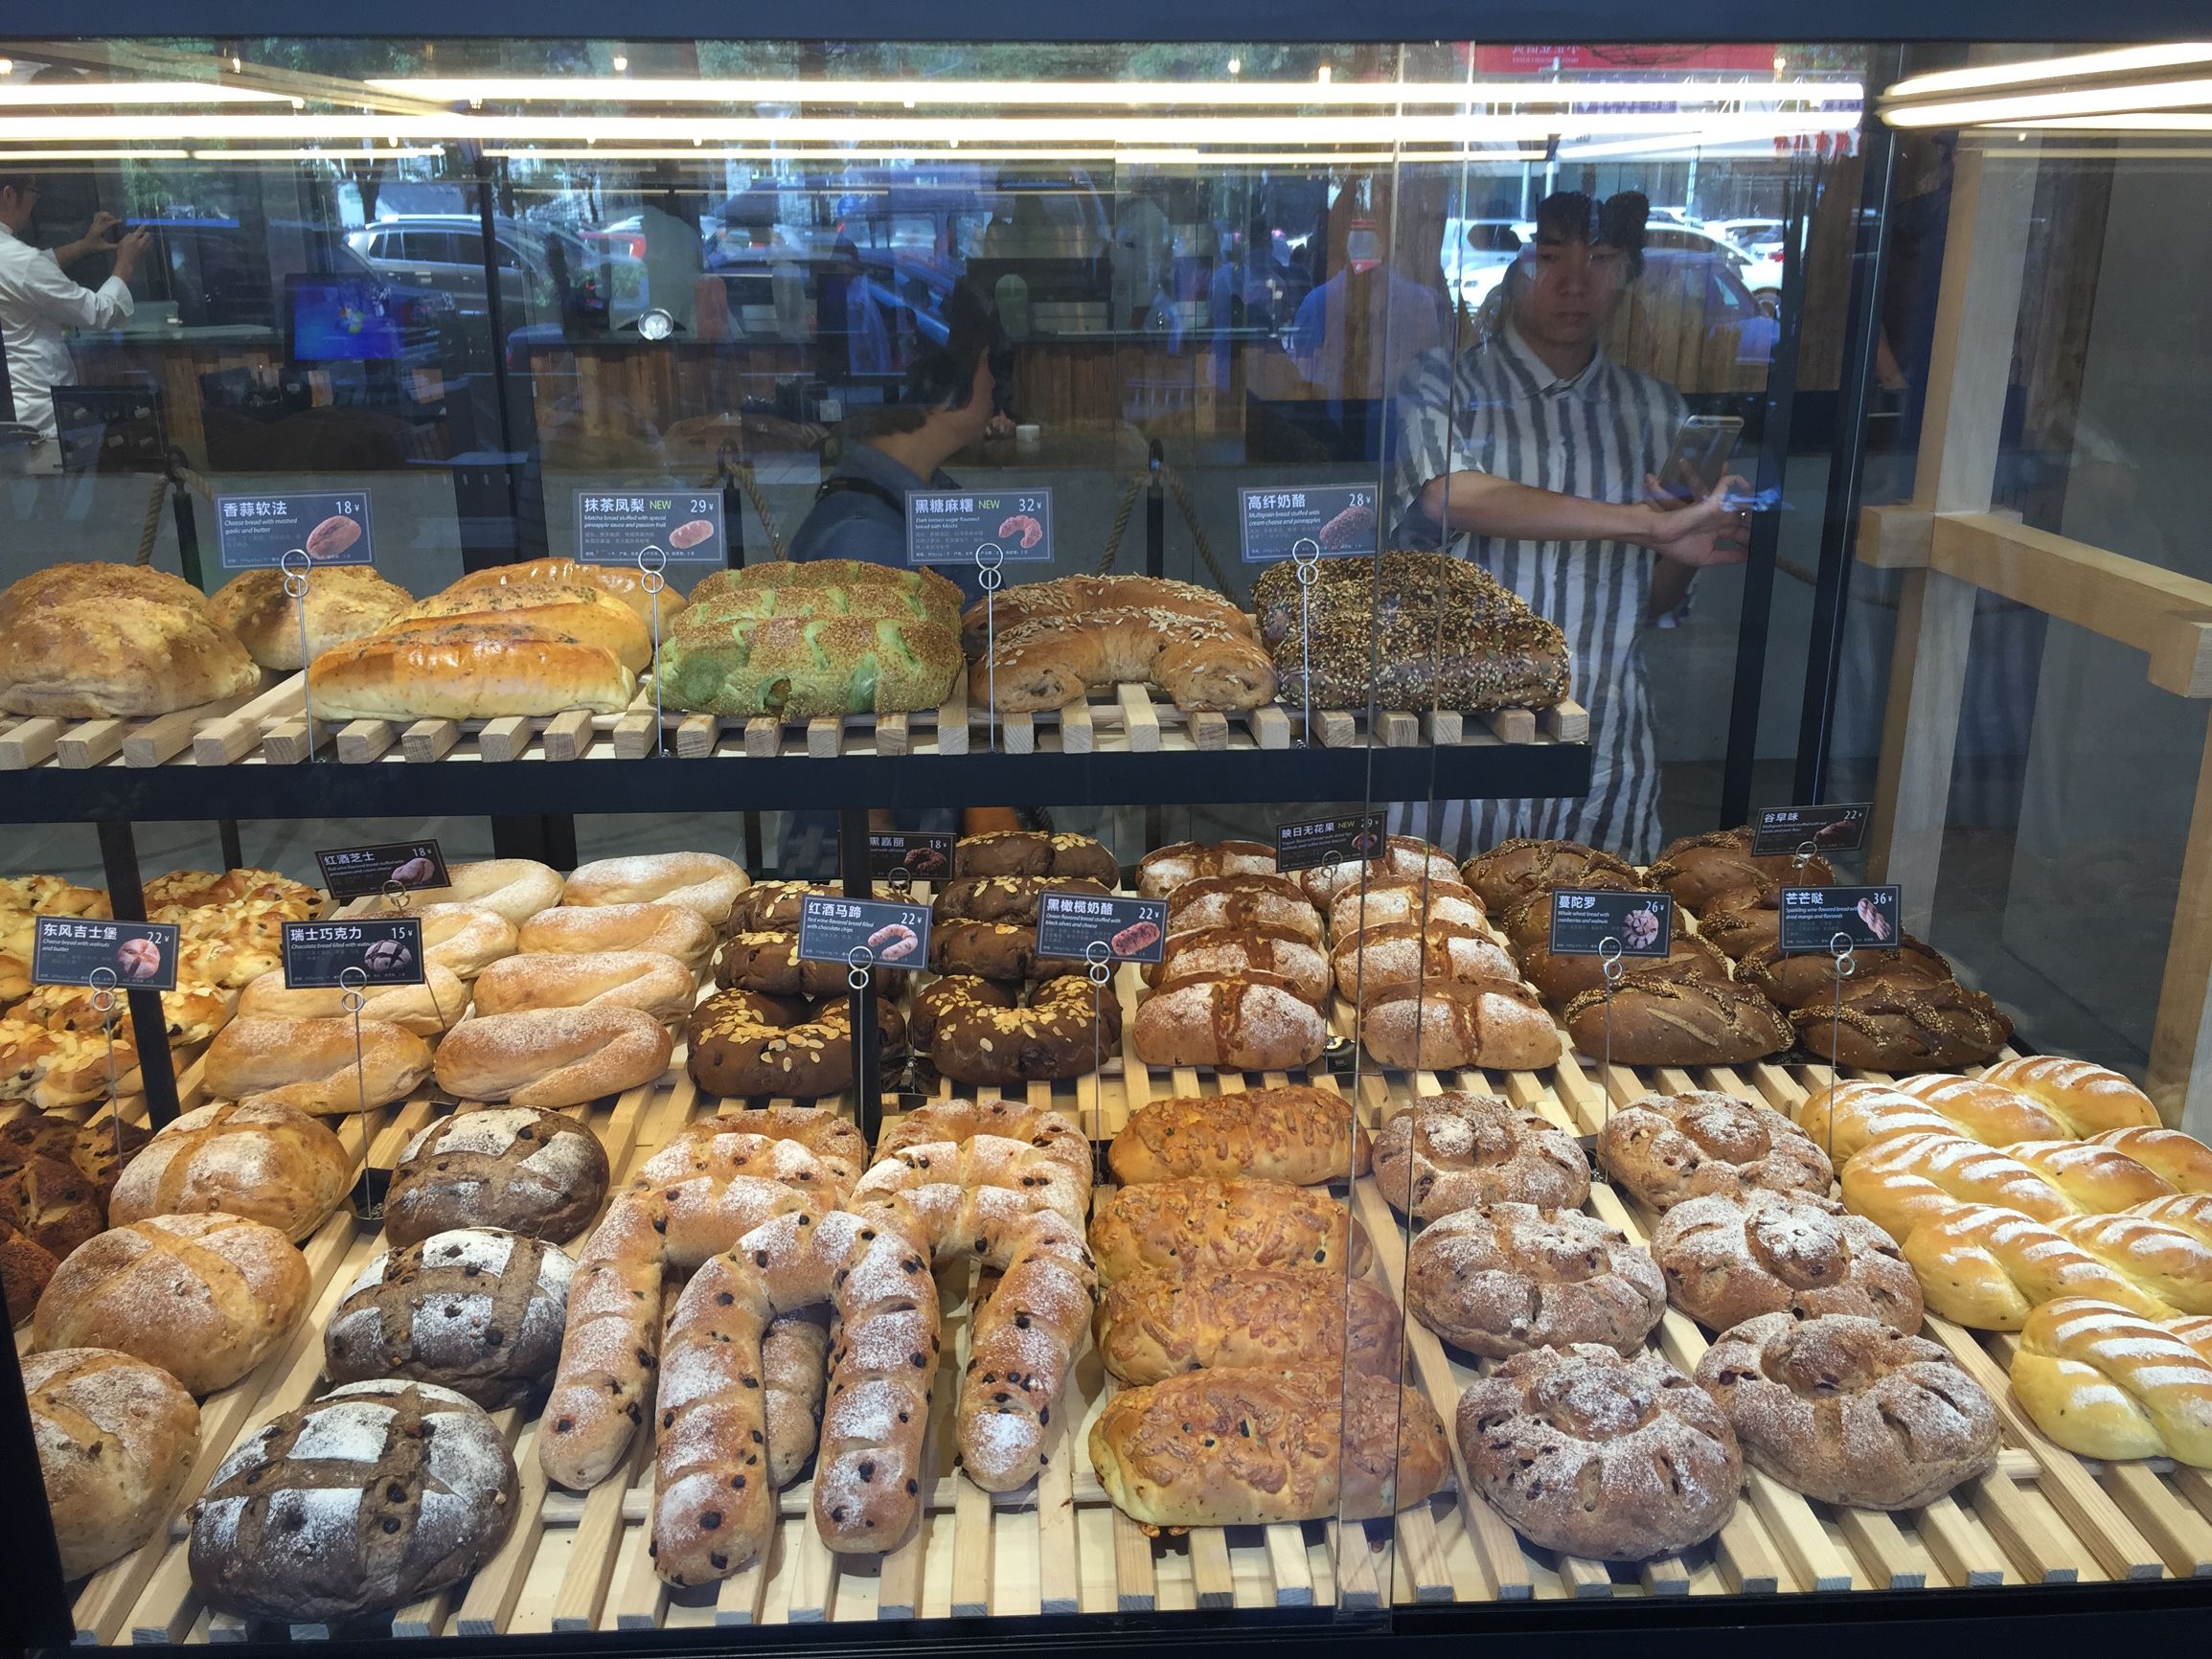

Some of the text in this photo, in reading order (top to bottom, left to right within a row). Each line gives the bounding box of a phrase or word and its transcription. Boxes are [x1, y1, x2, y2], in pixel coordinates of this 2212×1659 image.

[223, 501, 287, 517] 香蒜软法
[584, 498, 672, 512] 抹茶凤梨 NEW
[915, 498, 1000, 513] 黑糖麻糬 NEW
[1247, 493, 1306, 510] 高纤奶酪
[1281, 820, 1356, 838] 映日无花果 NEW
[324, 851, 376, 866] 红酒芝士
[1785, 892, 1824, 905] 芒芒哒
[808, 901, 862, 919] 红酒马蹄
[1046, 898, 1114, 916] 黑橄榄奶酪
[43, 922, 118, 941] 东风吉士堡
[290, 926, 362, 942] 瑞士巧克力
